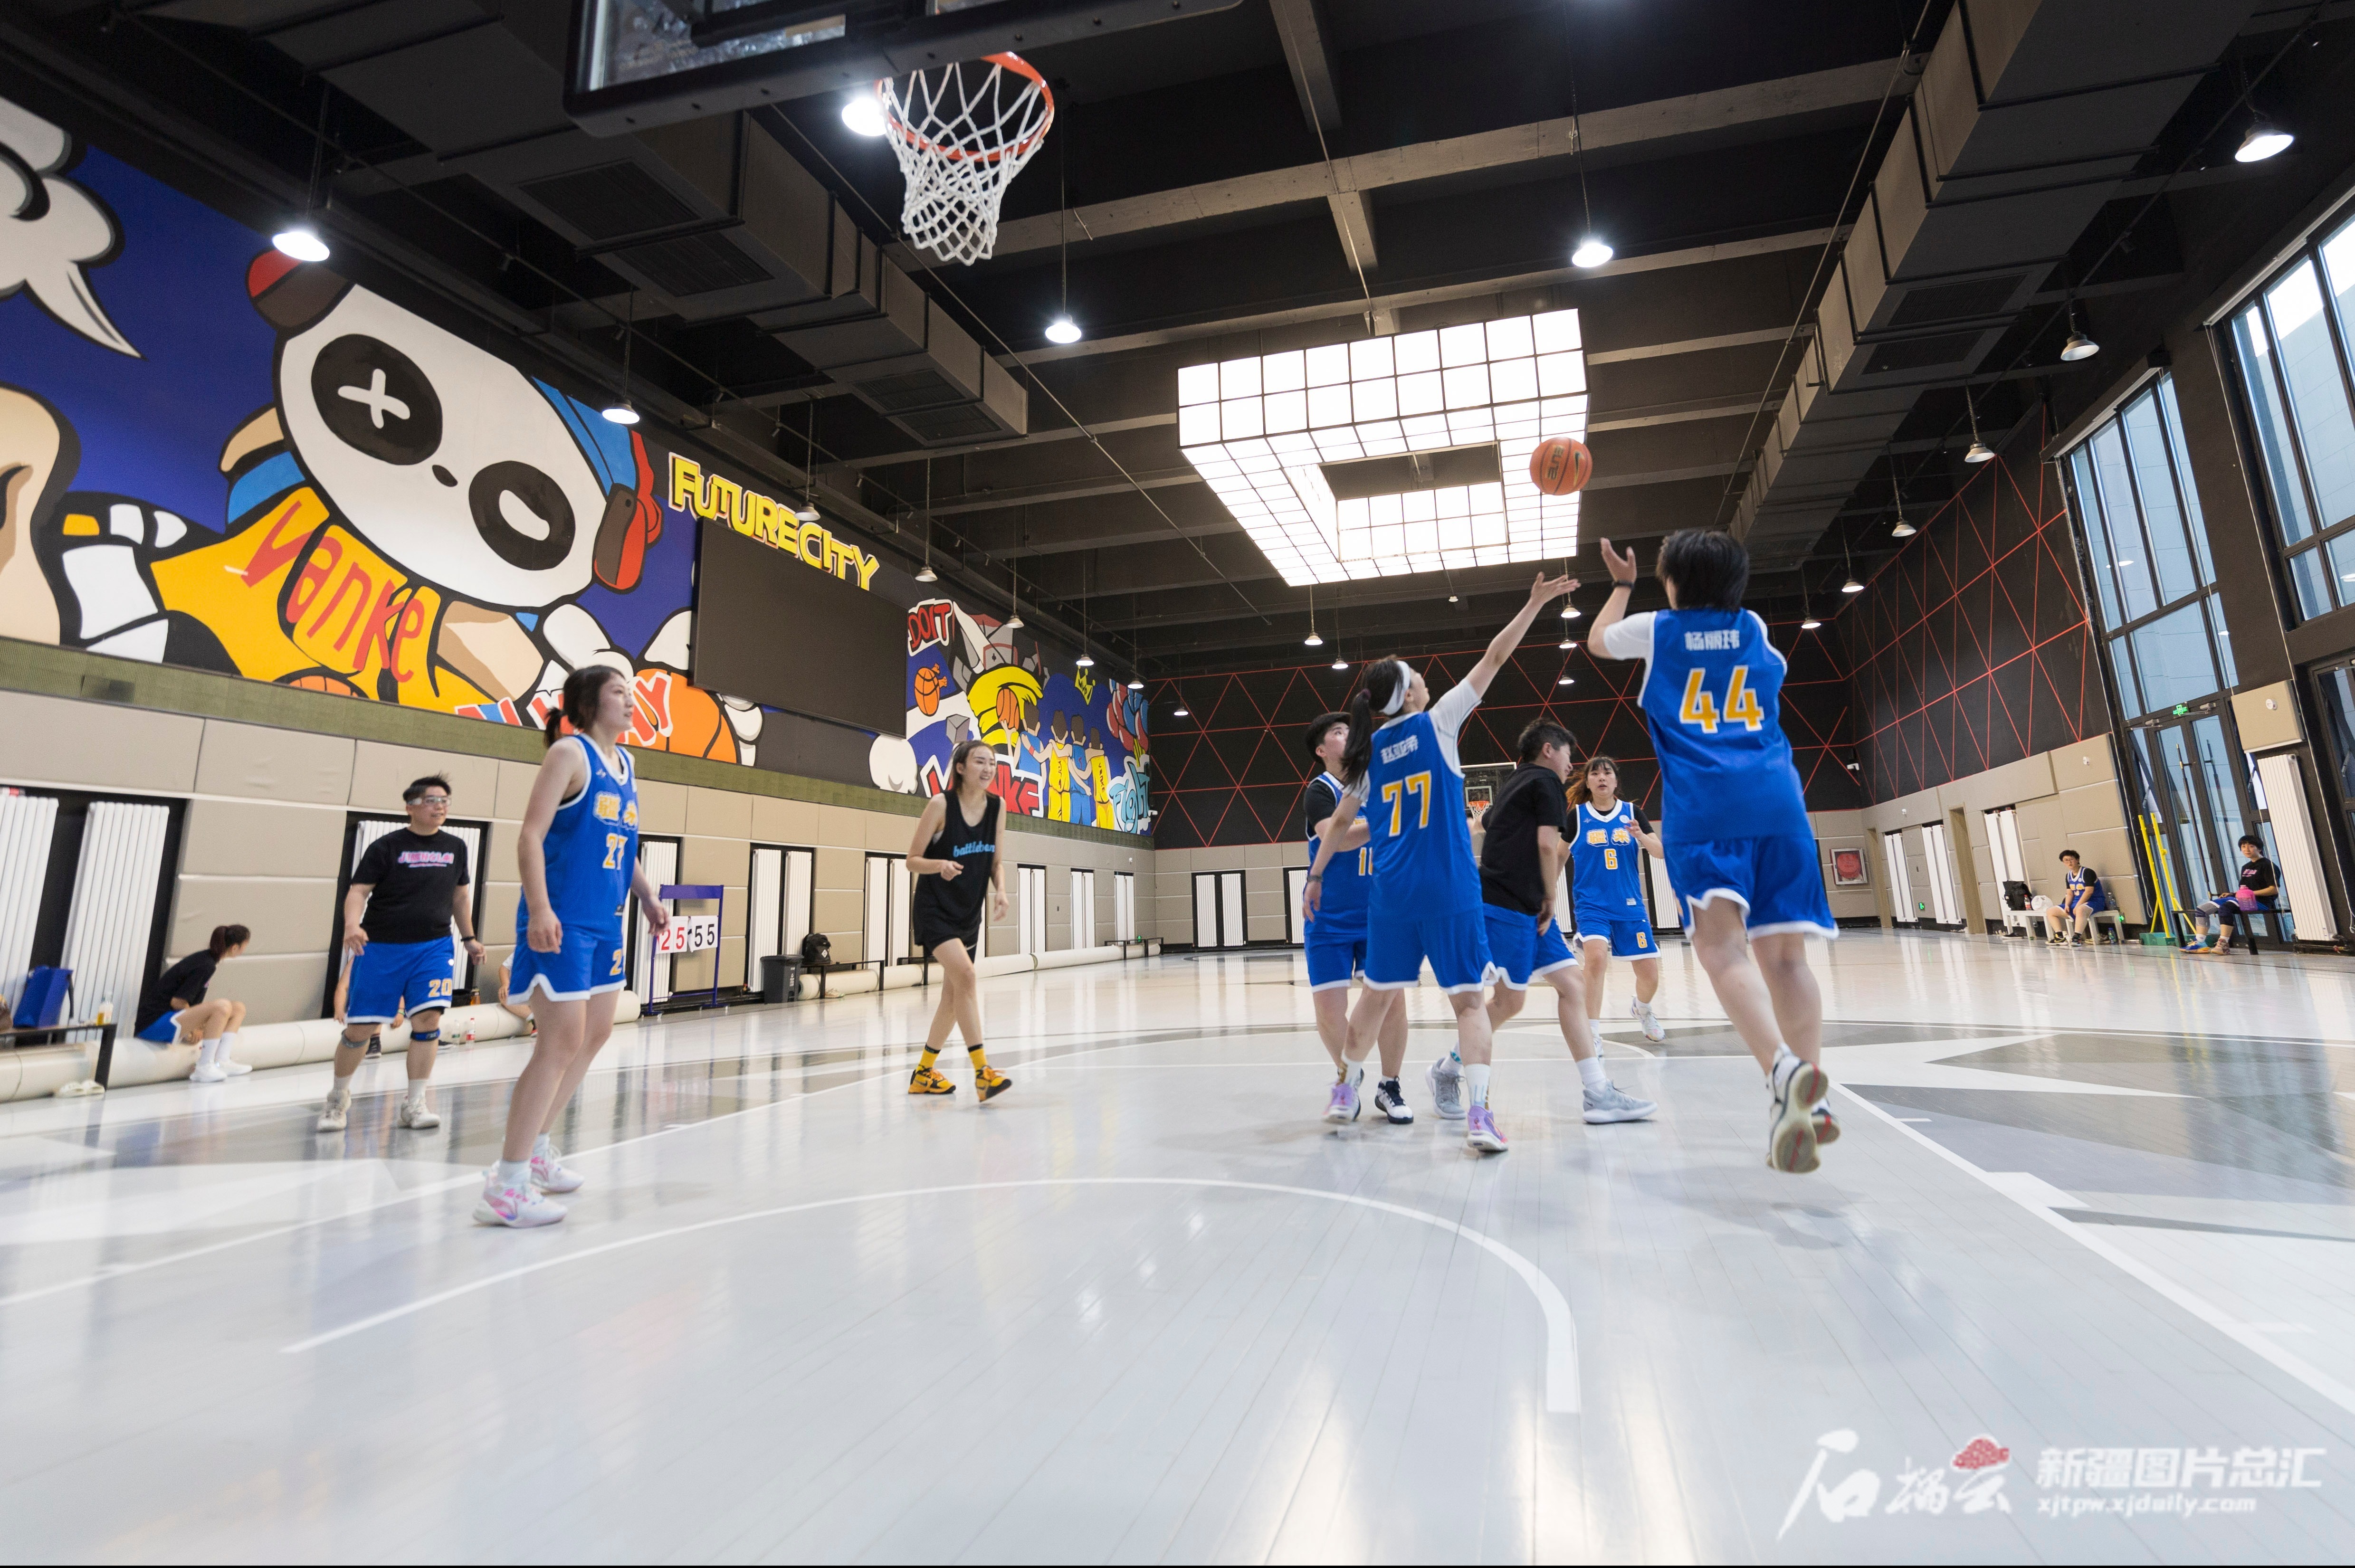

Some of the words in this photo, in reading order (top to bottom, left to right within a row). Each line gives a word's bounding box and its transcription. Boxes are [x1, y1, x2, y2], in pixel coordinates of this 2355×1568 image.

[1680, 665, 1764, 733] 44
[1382, 770, 1432, 837] 77
[602, 832, 629, 870] 27
[1604, 848, 1618, 870] 6
[695, 923, 715, 947] 55
[1636, 932, 1648, 949] 6
[609, 948, 624, 976] 2
[428, 978, 452, 998] 20
